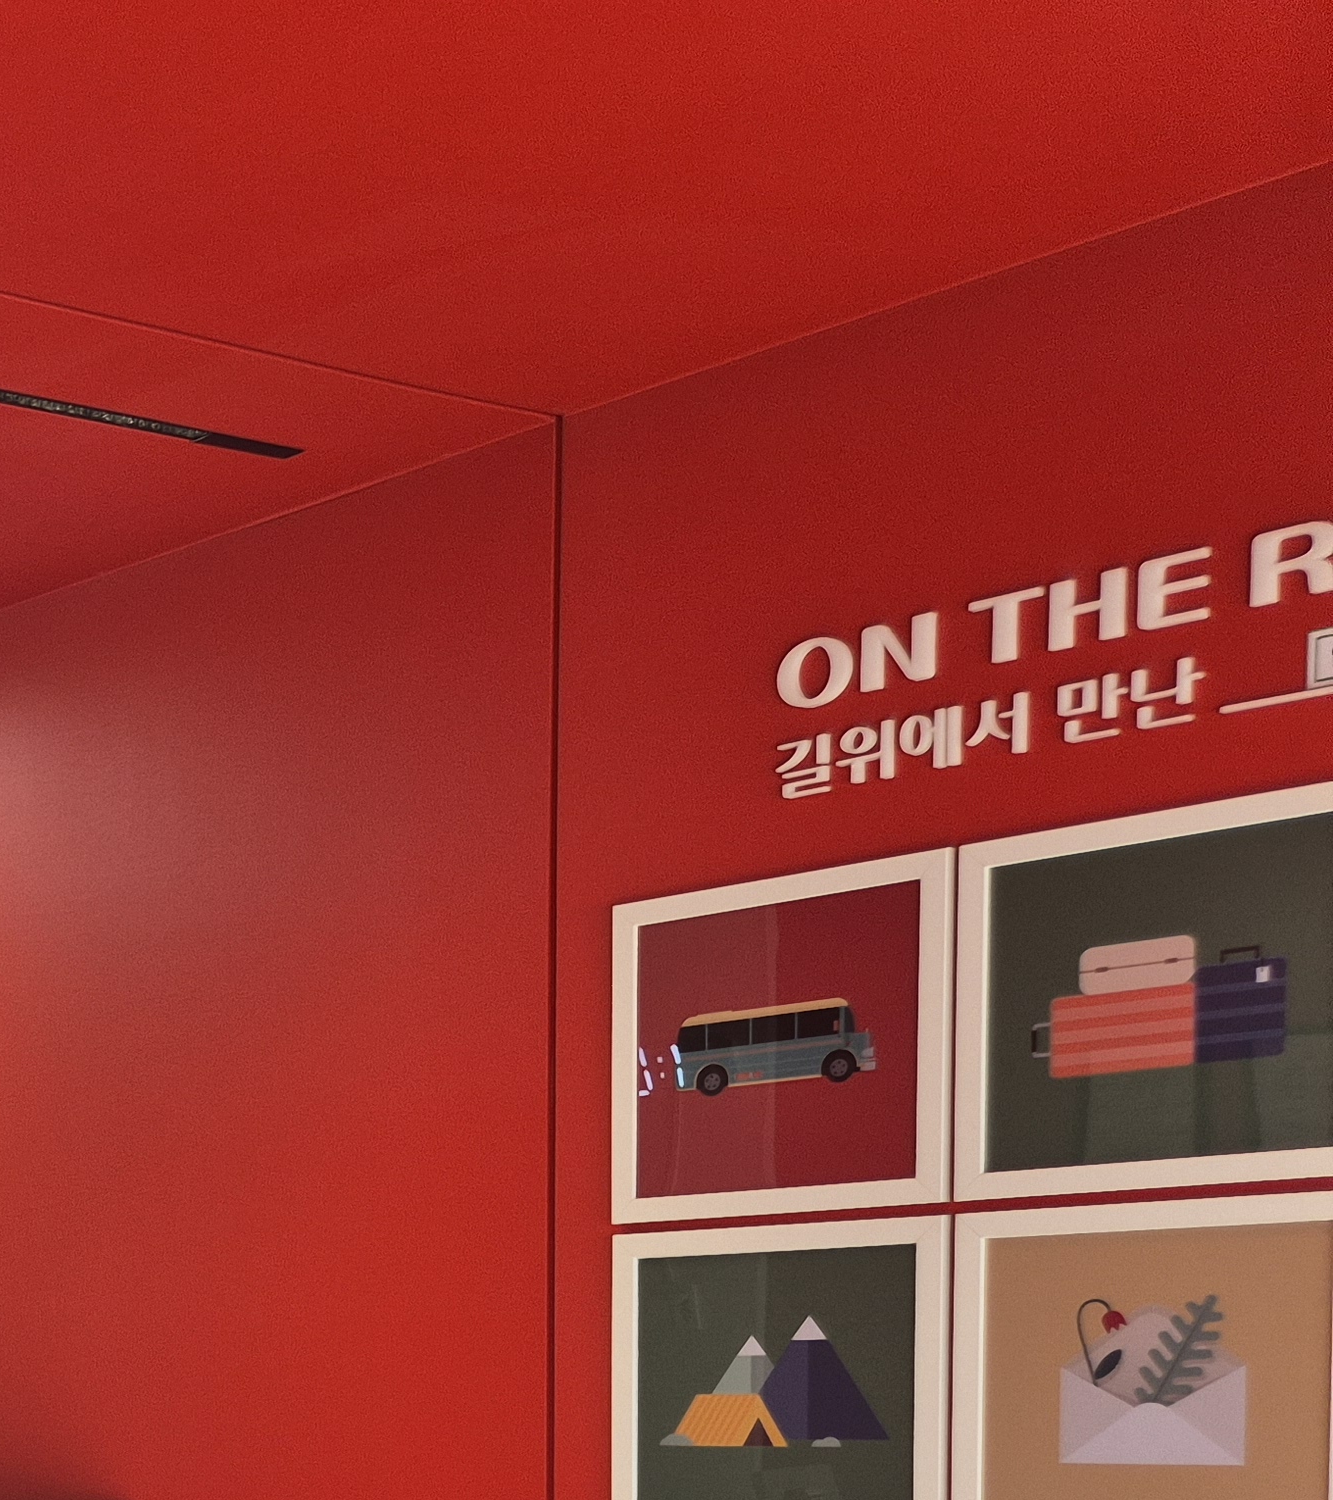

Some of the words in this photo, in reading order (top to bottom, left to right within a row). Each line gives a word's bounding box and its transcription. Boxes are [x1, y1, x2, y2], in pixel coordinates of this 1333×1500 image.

[776, 611, 938, 708] ON
[968, 546, 1212, 663] THE
[775, 691, 1031, 798] 길위에서
[1057, 656, 1206, 744] 만난
